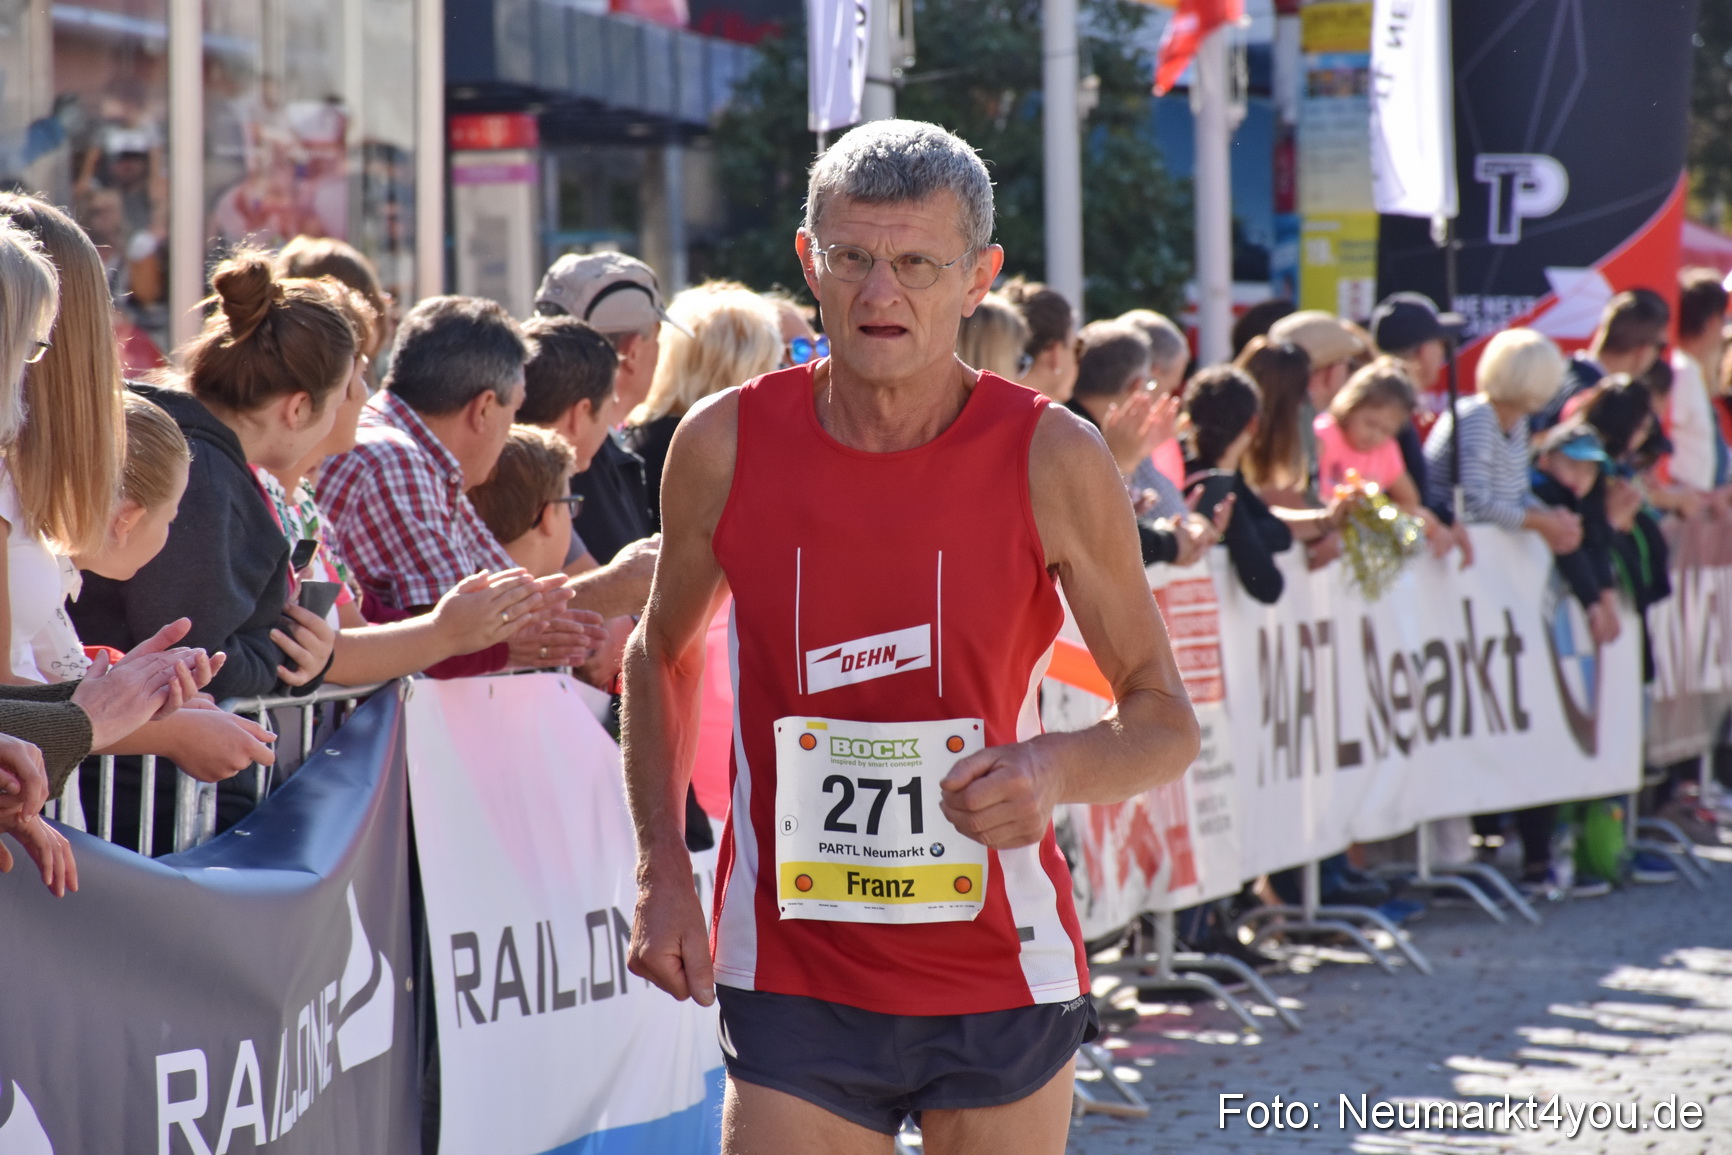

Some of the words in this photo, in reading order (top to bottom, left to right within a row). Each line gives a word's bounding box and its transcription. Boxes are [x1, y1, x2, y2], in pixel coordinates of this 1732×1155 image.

[841, 644, 896, 673] DEHN
[830, 736, 921, 759] BOCK
[830, 758, 857, 767] inspired
[858, 760, 866, 768] by
[867, 760, 888, 768] smart
[890, 759, 923, 768] concepts
[822, 774, 924, 835] 271
[784, 820, 792, 831] B
[819, 842, 860, 856] PARTL
[863, 846, 924, 858] Neumarkt
[847, 871, 915, 898] Franz
